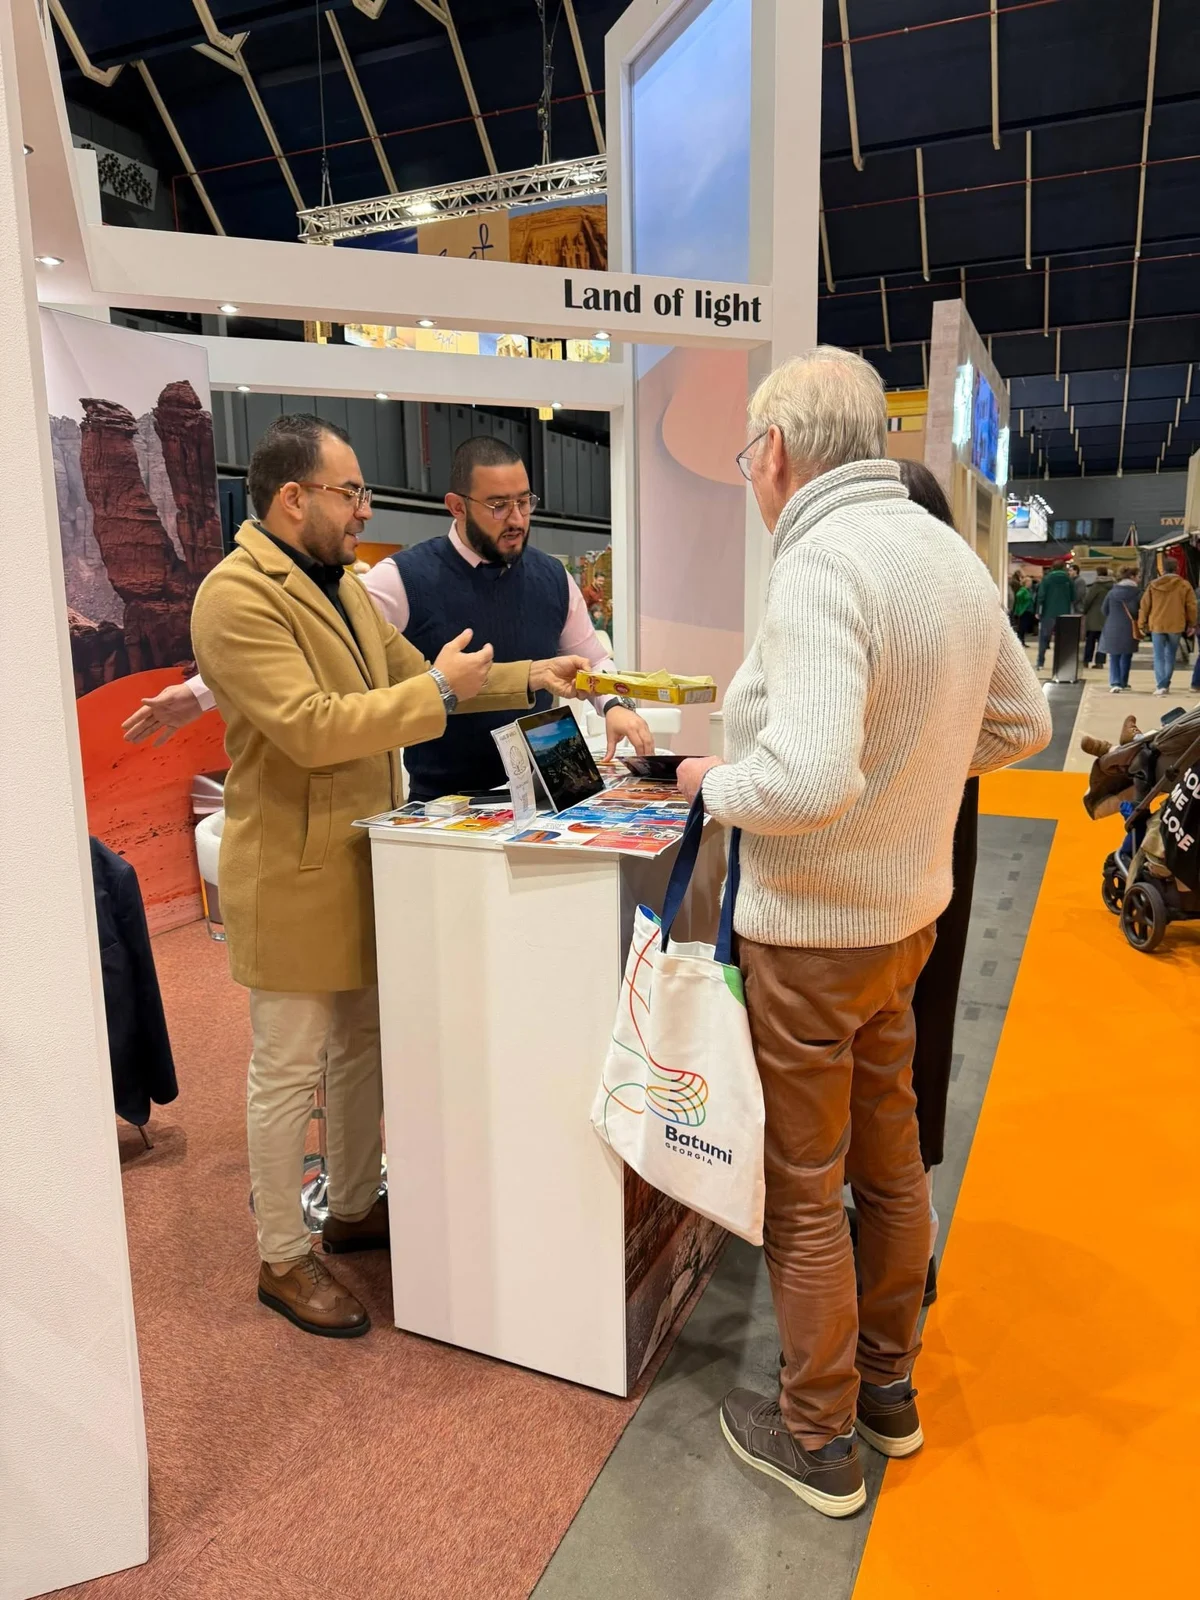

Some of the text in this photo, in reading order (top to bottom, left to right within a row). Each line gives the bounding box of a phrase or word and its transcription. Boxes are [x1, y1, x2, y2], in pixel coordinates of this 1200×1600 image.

[564, 278, 762, 327] Land of light
[1162, 807, 1195, 852] LOSE
[665, 1124, 733, 1166] Batumi
[665, 1142, 713, 1166] GEORGIA
